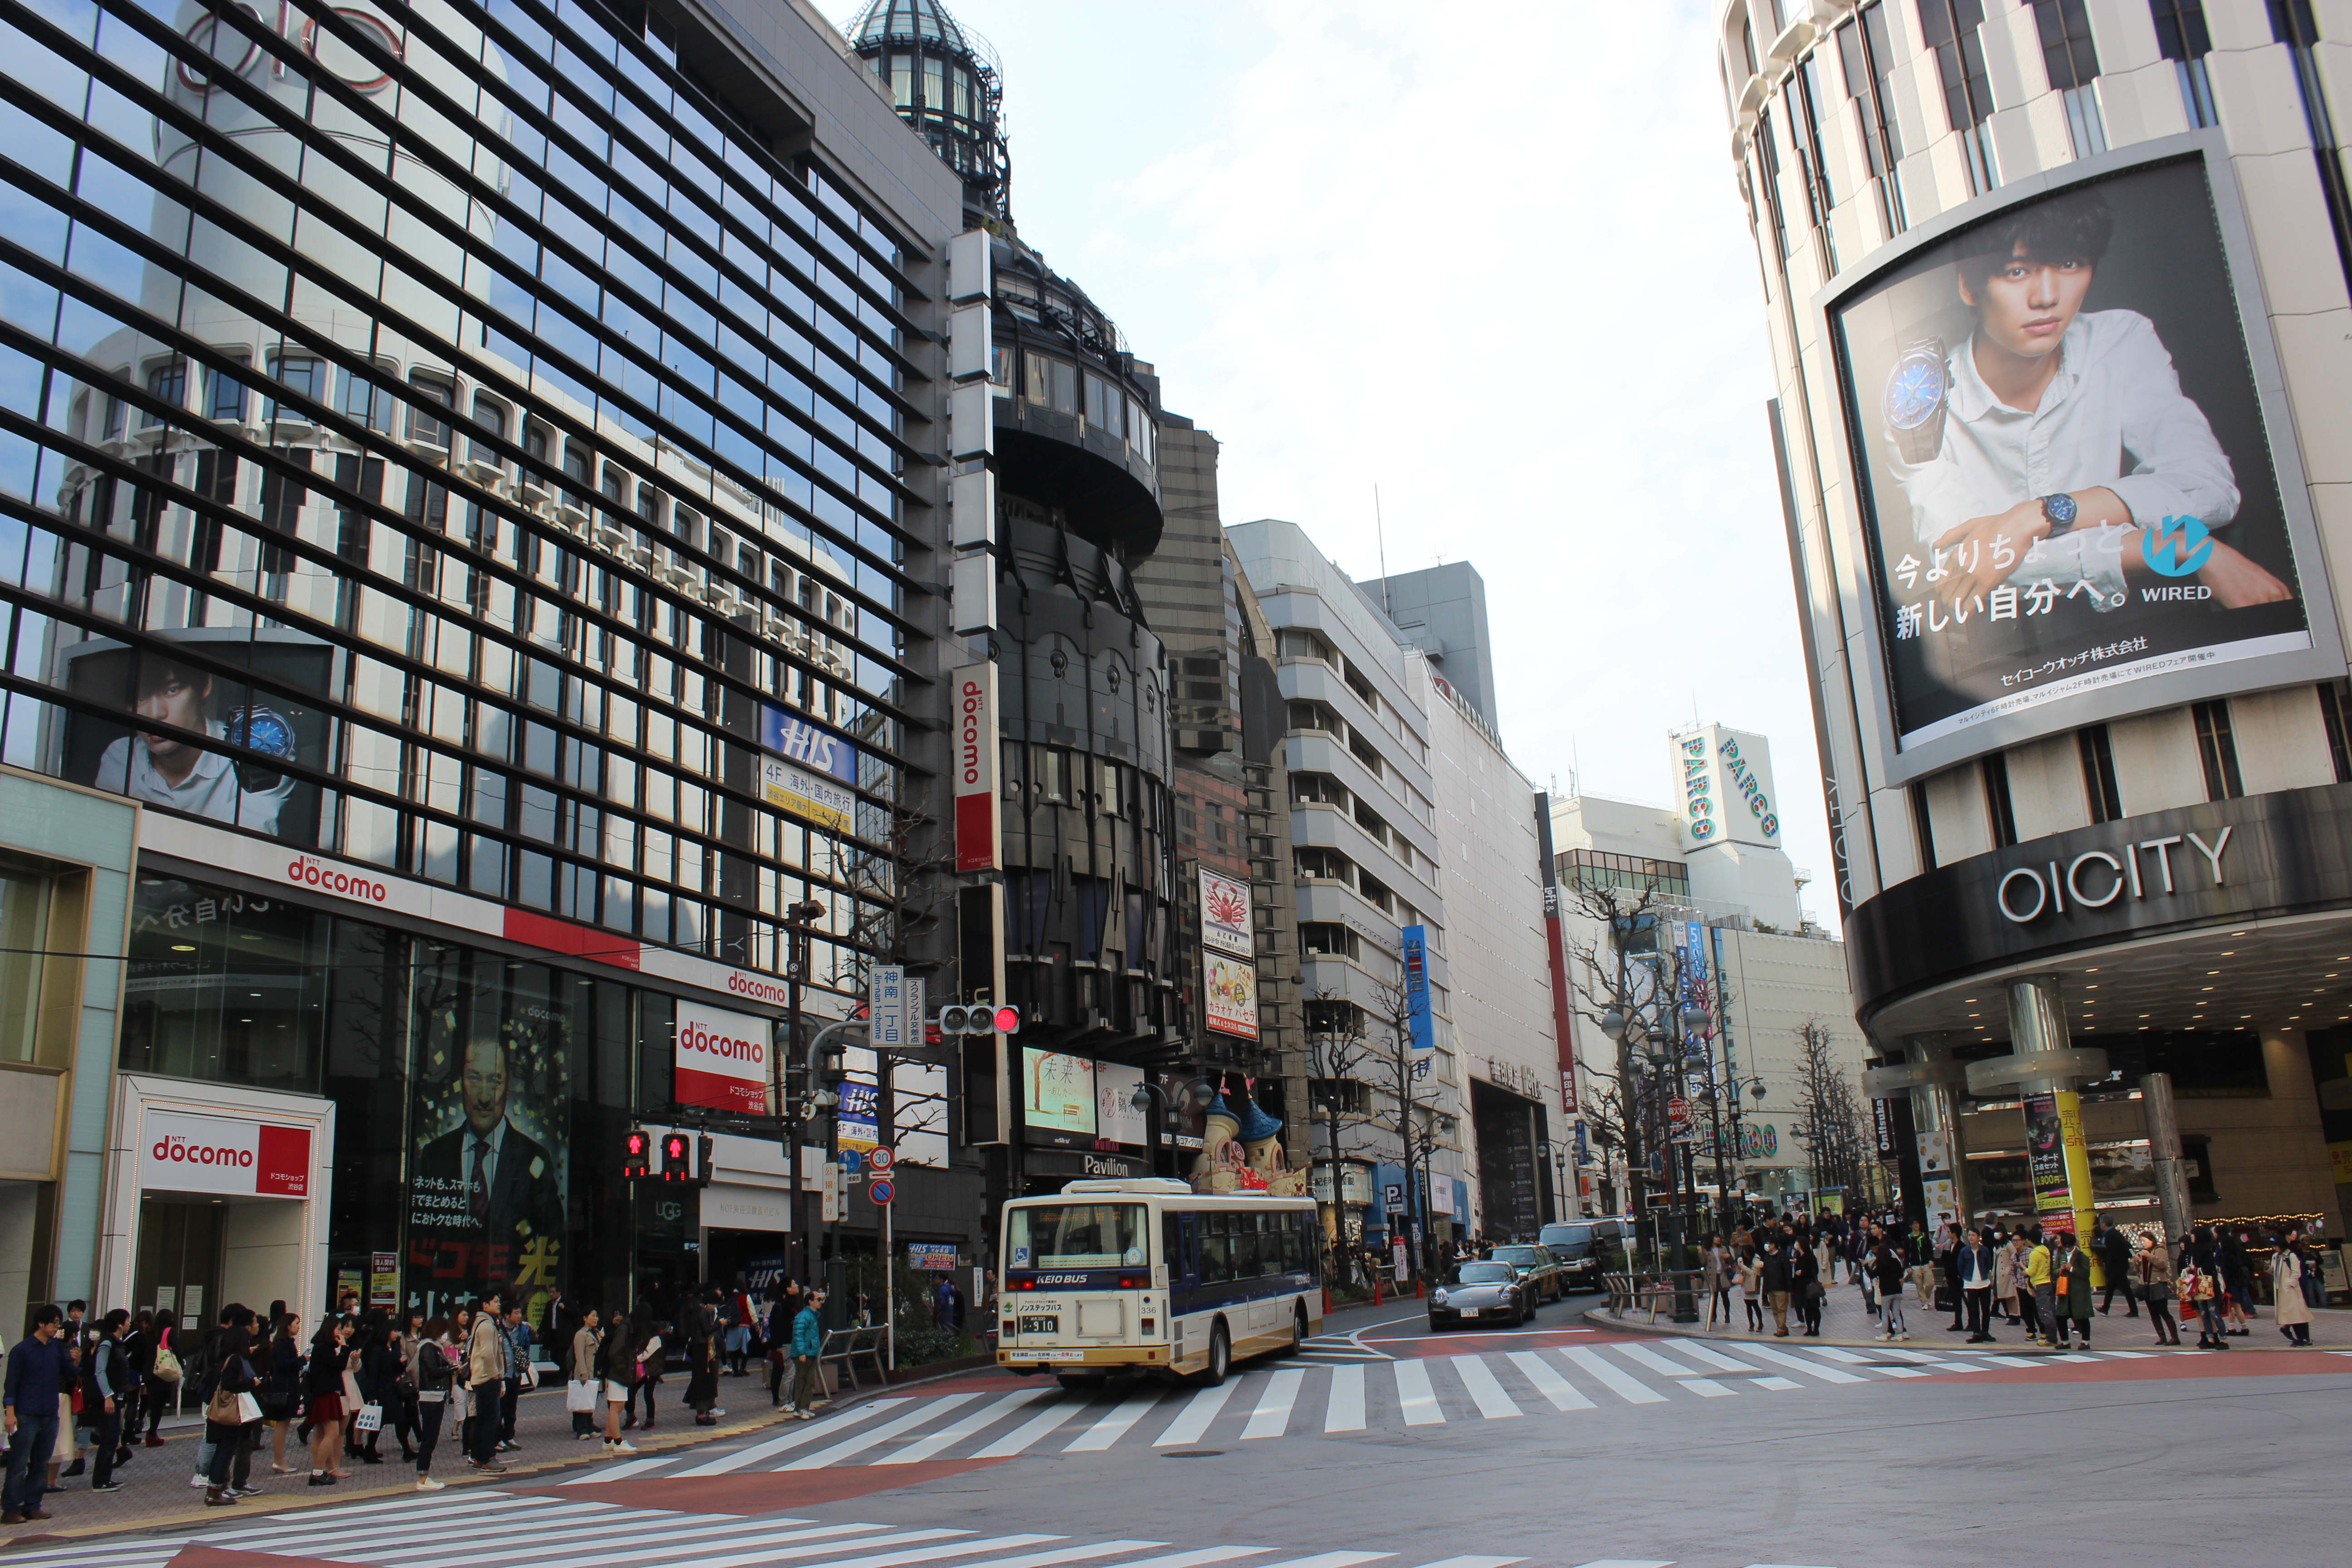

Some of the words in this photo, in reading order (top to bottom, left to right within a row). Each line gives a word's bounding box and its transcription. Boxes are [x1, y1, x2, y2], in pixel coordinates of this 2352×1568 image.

[1894, 519, 2126, 590] 今よりちょっと
[2141, 585, 2213, 603] WIRED
[1896, 577, 2127, 640] 新しい自分へ。
[1999, 635, 2148, 687] セイコーウオッチ株式会社
[962, 681, 982, 784] docomo
[766, 764, 783, 781] 4F
[790, 773, 851, 811] 海外・国内旅行
[1681, 736, 1715, 840] PARCO
[1718, 737, 1778, 838] PARCO
[767, 788, 808, 813] 渋谷エリア最大
[306, 857, 321, 867] NTT
[288, 855, 386, 902] docomo
[1997, 826, 2233, 923] OICITY
[728, 970, 785, 1003] docomo
[874, 973, 882, 1003] Jin-nan
[527, 1004, 567, 1023] docomo
[884, 970, 899, 1042] 神南一丁目
[910, 981, 920, 1044] スクランブル交差点
[1209, 1000, 1233, 1017] カラオケ
[1235, 1007, 1255, 1023] パセラ
[695, 1022, 708, 1031] NTT
[681, 1021, 763, 1063] docomo
[1043, 1058, 1073, 1084] 未来
[1097, 1062, 1107, 1073] 8F
[1418, 1060, 1430, 1077] P
[1160, 1074, 1169, 1084] 7F
[729, 1085, 765, 1099] ドコモショップ
[1563, 1071, 1574, 1107] 無印良品
[748, 1101, 764, 1112] 渋谷店
[1668, 1107, 1686, 1116] 消火栓
[152, 1135, 253, 1167] docomo
[875, 1153, 888, 1164] 30
[1084, 1155, 1128, 1177] Pavilion
[2034, 1161, 2059, 1171] 3点セット
[270, 1172, 305, 1182] ドコモショップ
[412, 1175, 481, 1193] ネットも、スマホも
[288, 1183, 304, 1191] 渋谷店
[1387, 1186, 1399, 1203] P
[656, 1201, 681, 1220] UGG
[2038, 1200, 2045, 1209] 8F
[926, 1253, 954, 1261] OPEN
[1036, 1275, 1063, 1284] KEIO
[1063, 1274, 1088, 1284] BUS
[1019, 1303, 1063, 1312] ノンステップバス
